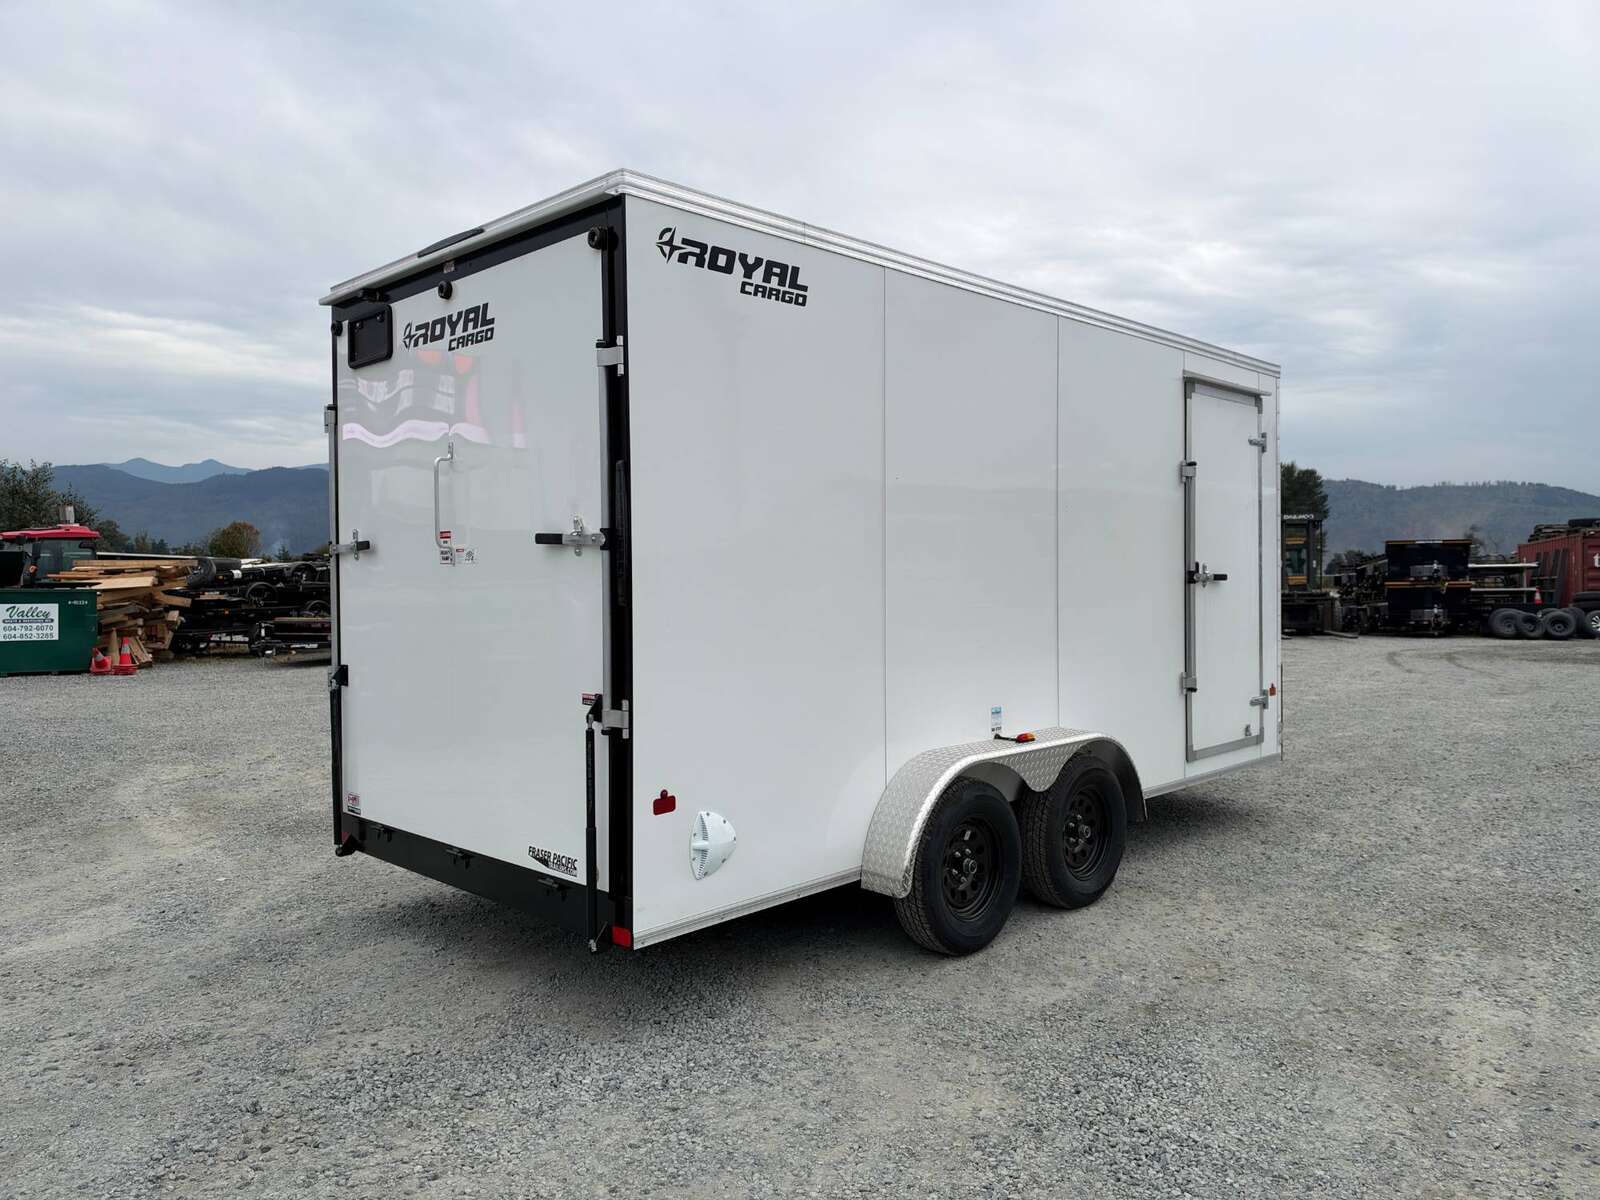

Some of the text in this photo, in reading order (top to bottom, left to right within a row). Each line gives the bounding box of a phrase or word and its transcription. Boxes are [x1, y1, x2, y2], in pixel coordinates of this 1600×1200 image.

[677, 237, 809, 293] ROYAL
[740, 281, 808, 307] CARGO
[413, 302, 496, 348] ROYAL
[448, 326, 495, 352] CARGO
[6, 605, 50, 619] Valley
[528, 846, 578, 870] FRASER PACIFIC
